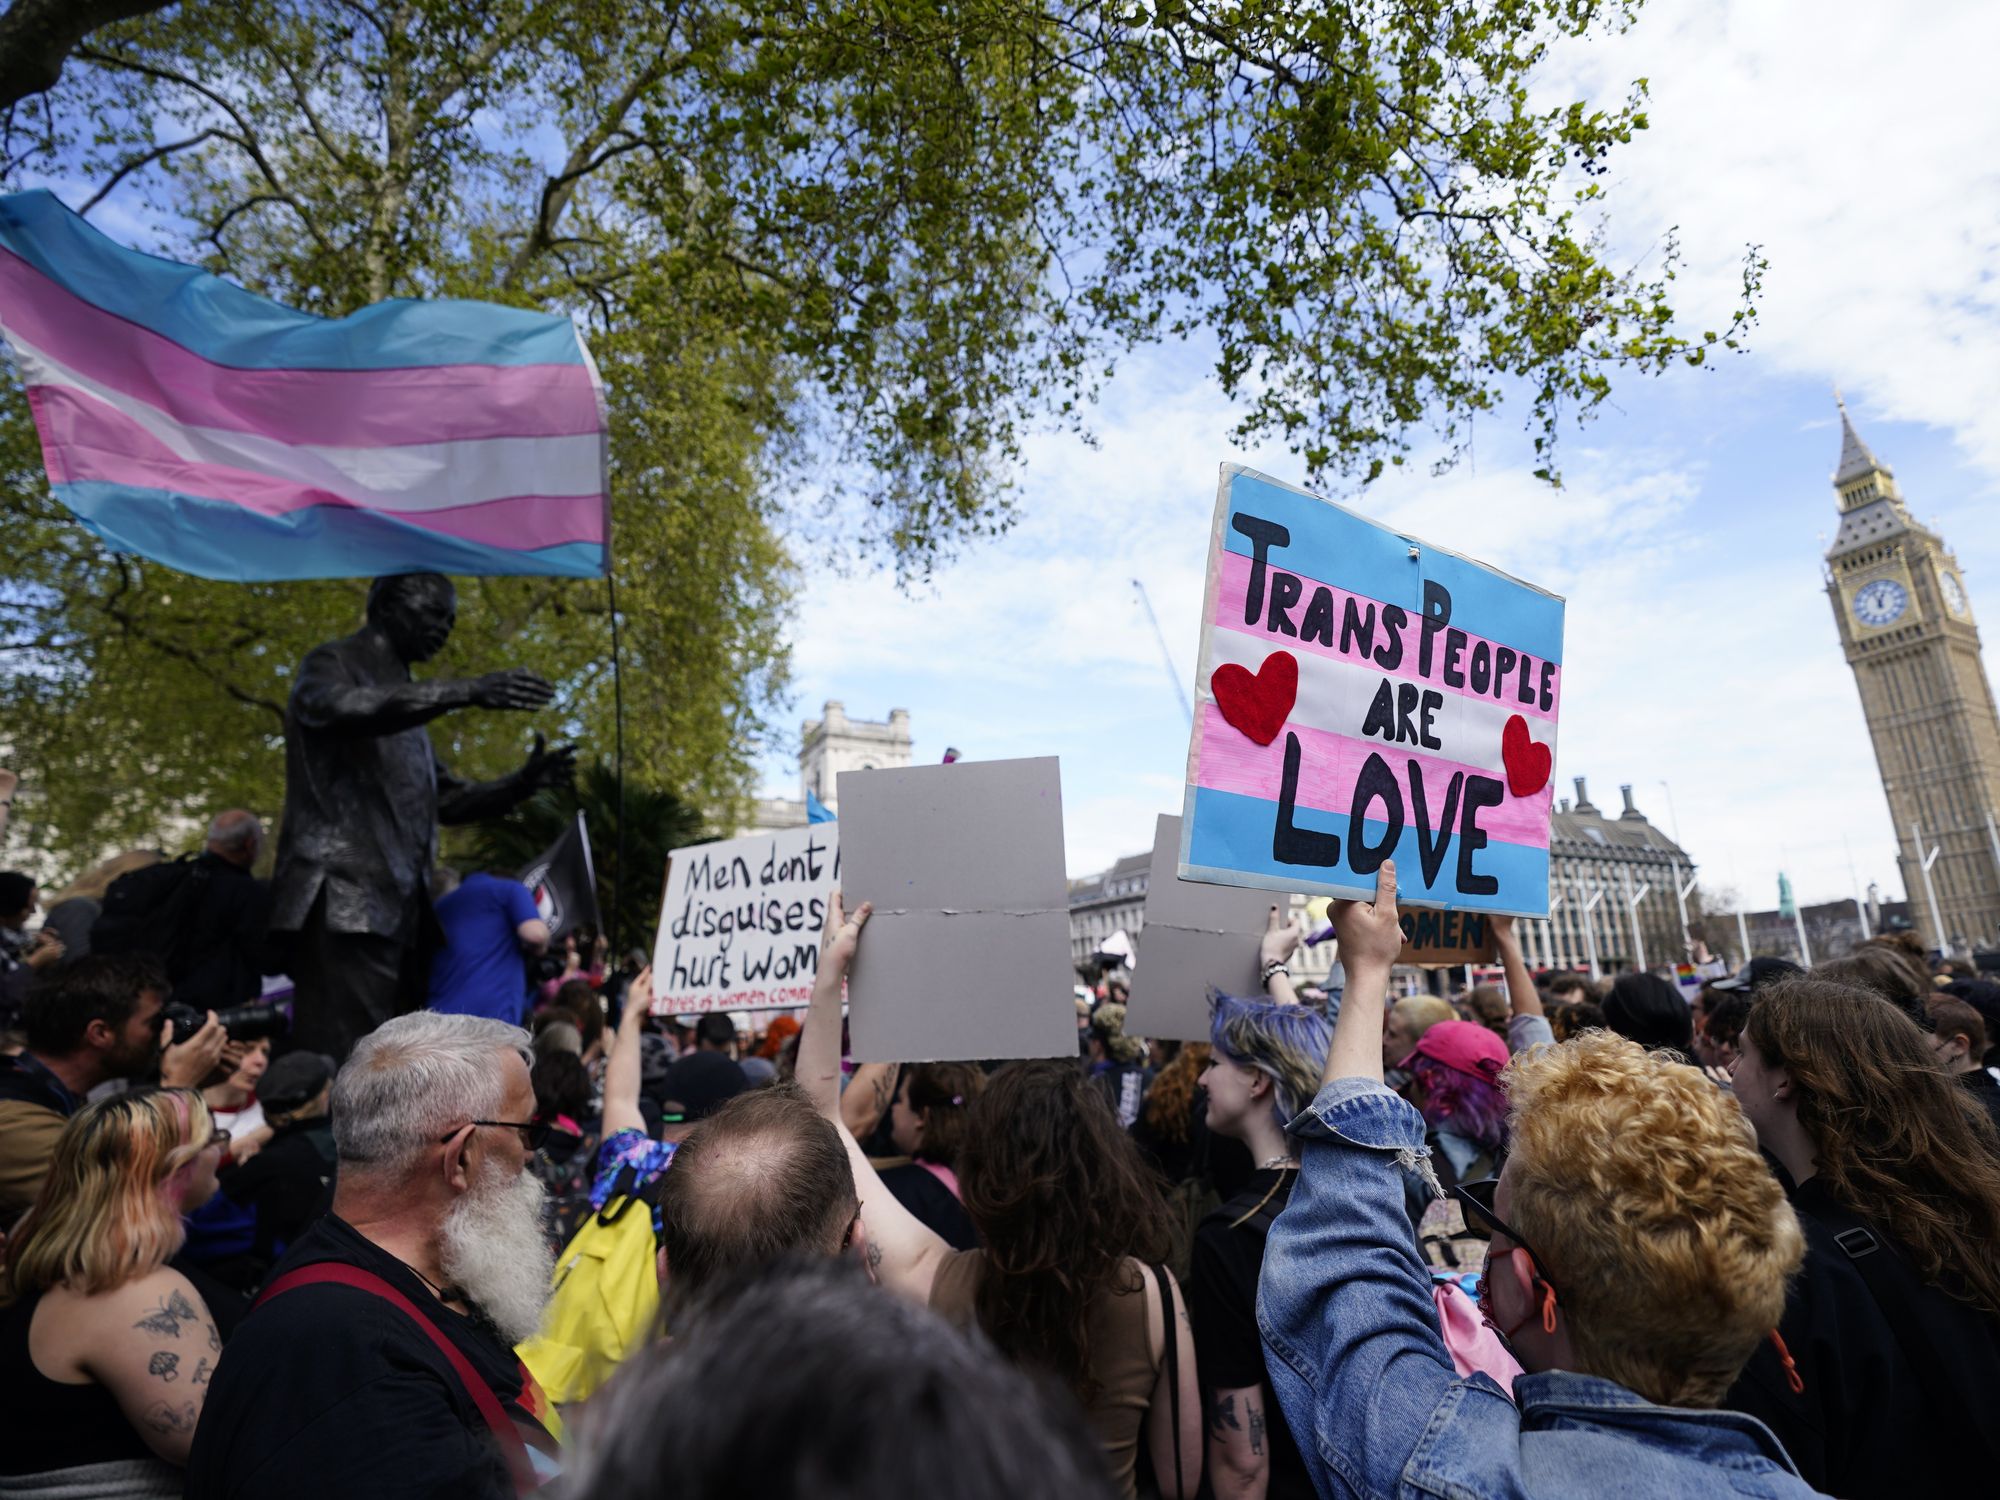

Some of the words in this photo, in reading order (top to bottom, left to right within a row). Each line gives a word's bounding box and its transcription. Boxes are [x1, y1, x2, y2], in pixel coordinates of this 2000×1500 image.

[1231, 511, 1408, 671] TRANS
[1418, 578, 1556, 712] PEOPLE
[1362, 677, 1444, 751] ARE
[1273, 731, 1505, 896] LOVE
[684, 853, 751, 896] Men
[760, 834, 826, 887] dont
[671, 892, 825, 952] disguises
[1399, 909, 1485, 950] OMEN
[669, 943, 730, 992] hurt
[743, 944, 818, 982] wom
[717, 990, 766, 1007] women
[769, 987, 813, 1004] comm
